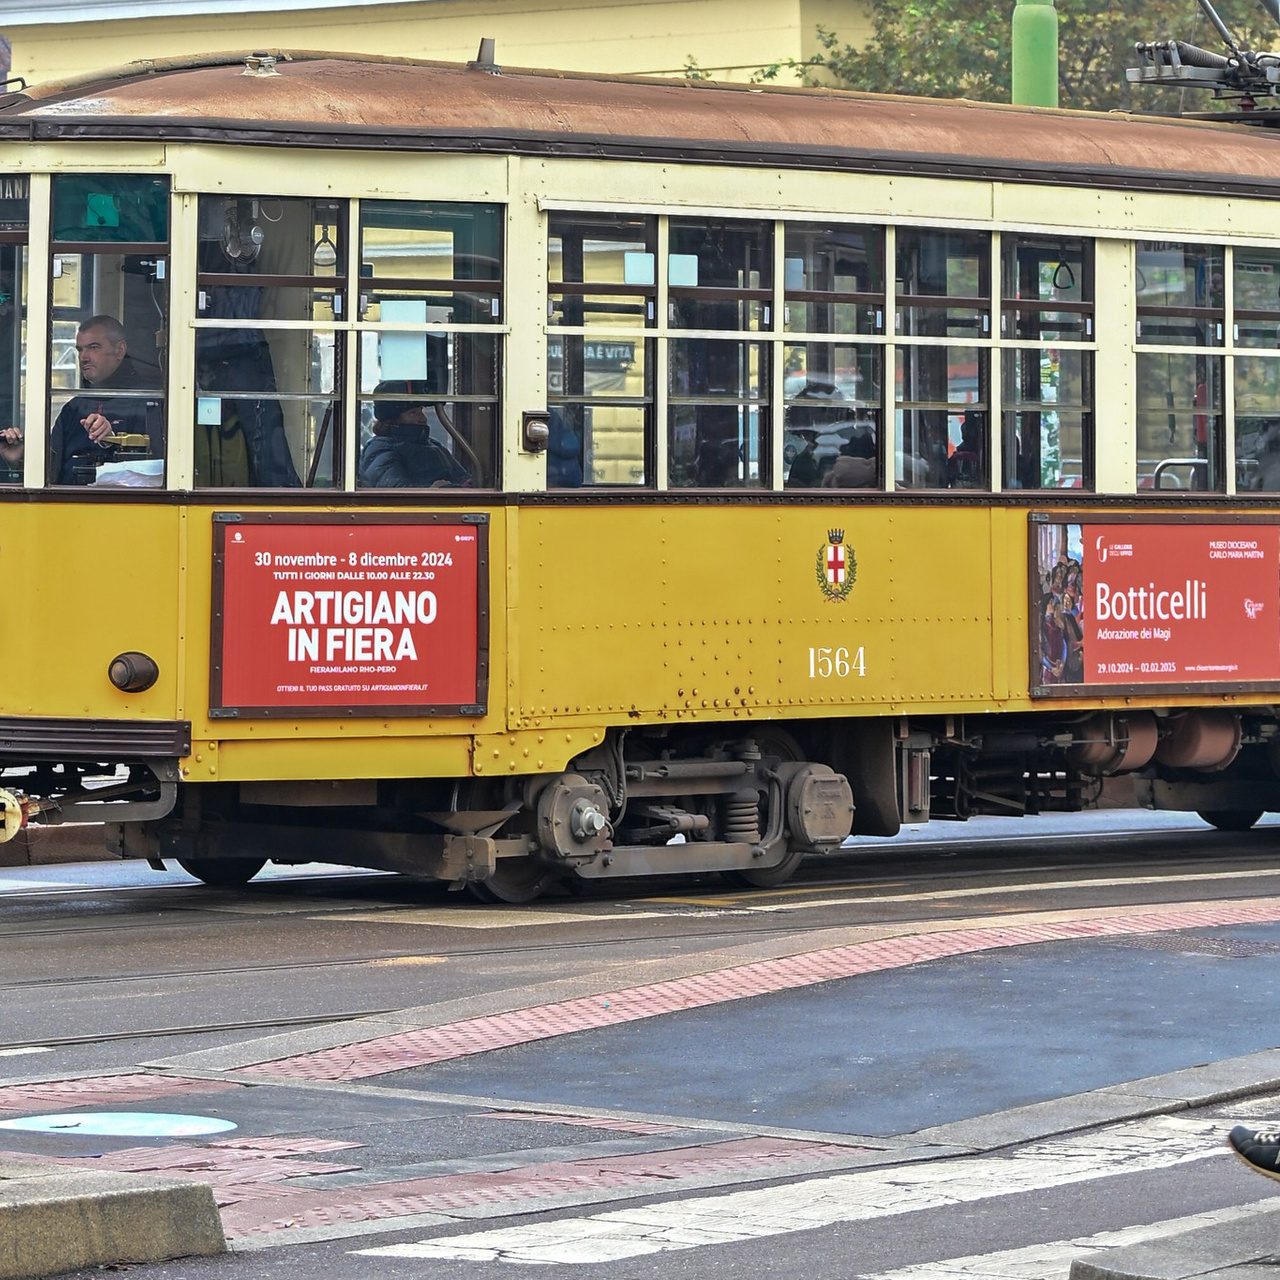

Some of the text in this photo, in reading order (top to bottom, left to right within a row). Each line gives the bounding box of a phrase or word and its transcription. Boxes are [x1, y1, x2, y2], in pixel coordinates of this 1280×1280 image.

[254, 552, 271, 567] 30
[274, 552, 337, 567] novembre
[348, 552, 357, 567] 8
[360, 552, 418, 567] dicembre
[421, 552, 453, 567] 2024
[273, 572, 298, 580] TUTTI
[304, 572, 335, 580] GIORNI
[337, 572, 365, 580] DALLE
[366, 572, 388, 580] 10.00
[390, 572, 411, 580] ALLE
[412, 572, 435, 580] 22.30
[270, 590, 438, 625] ARTIGIANO
[1096, 580, 1207, 621] Botticelli
[288, 627, 418, 661] IN FIERA
[1097, 627, 1171, 641] Adorazione dei Magi
[808, 646, 867, 678] 1564
[1097, 663, 1134, 673] 29.10.2024
[1140, 662, 1177, 673] 02.02.2025
